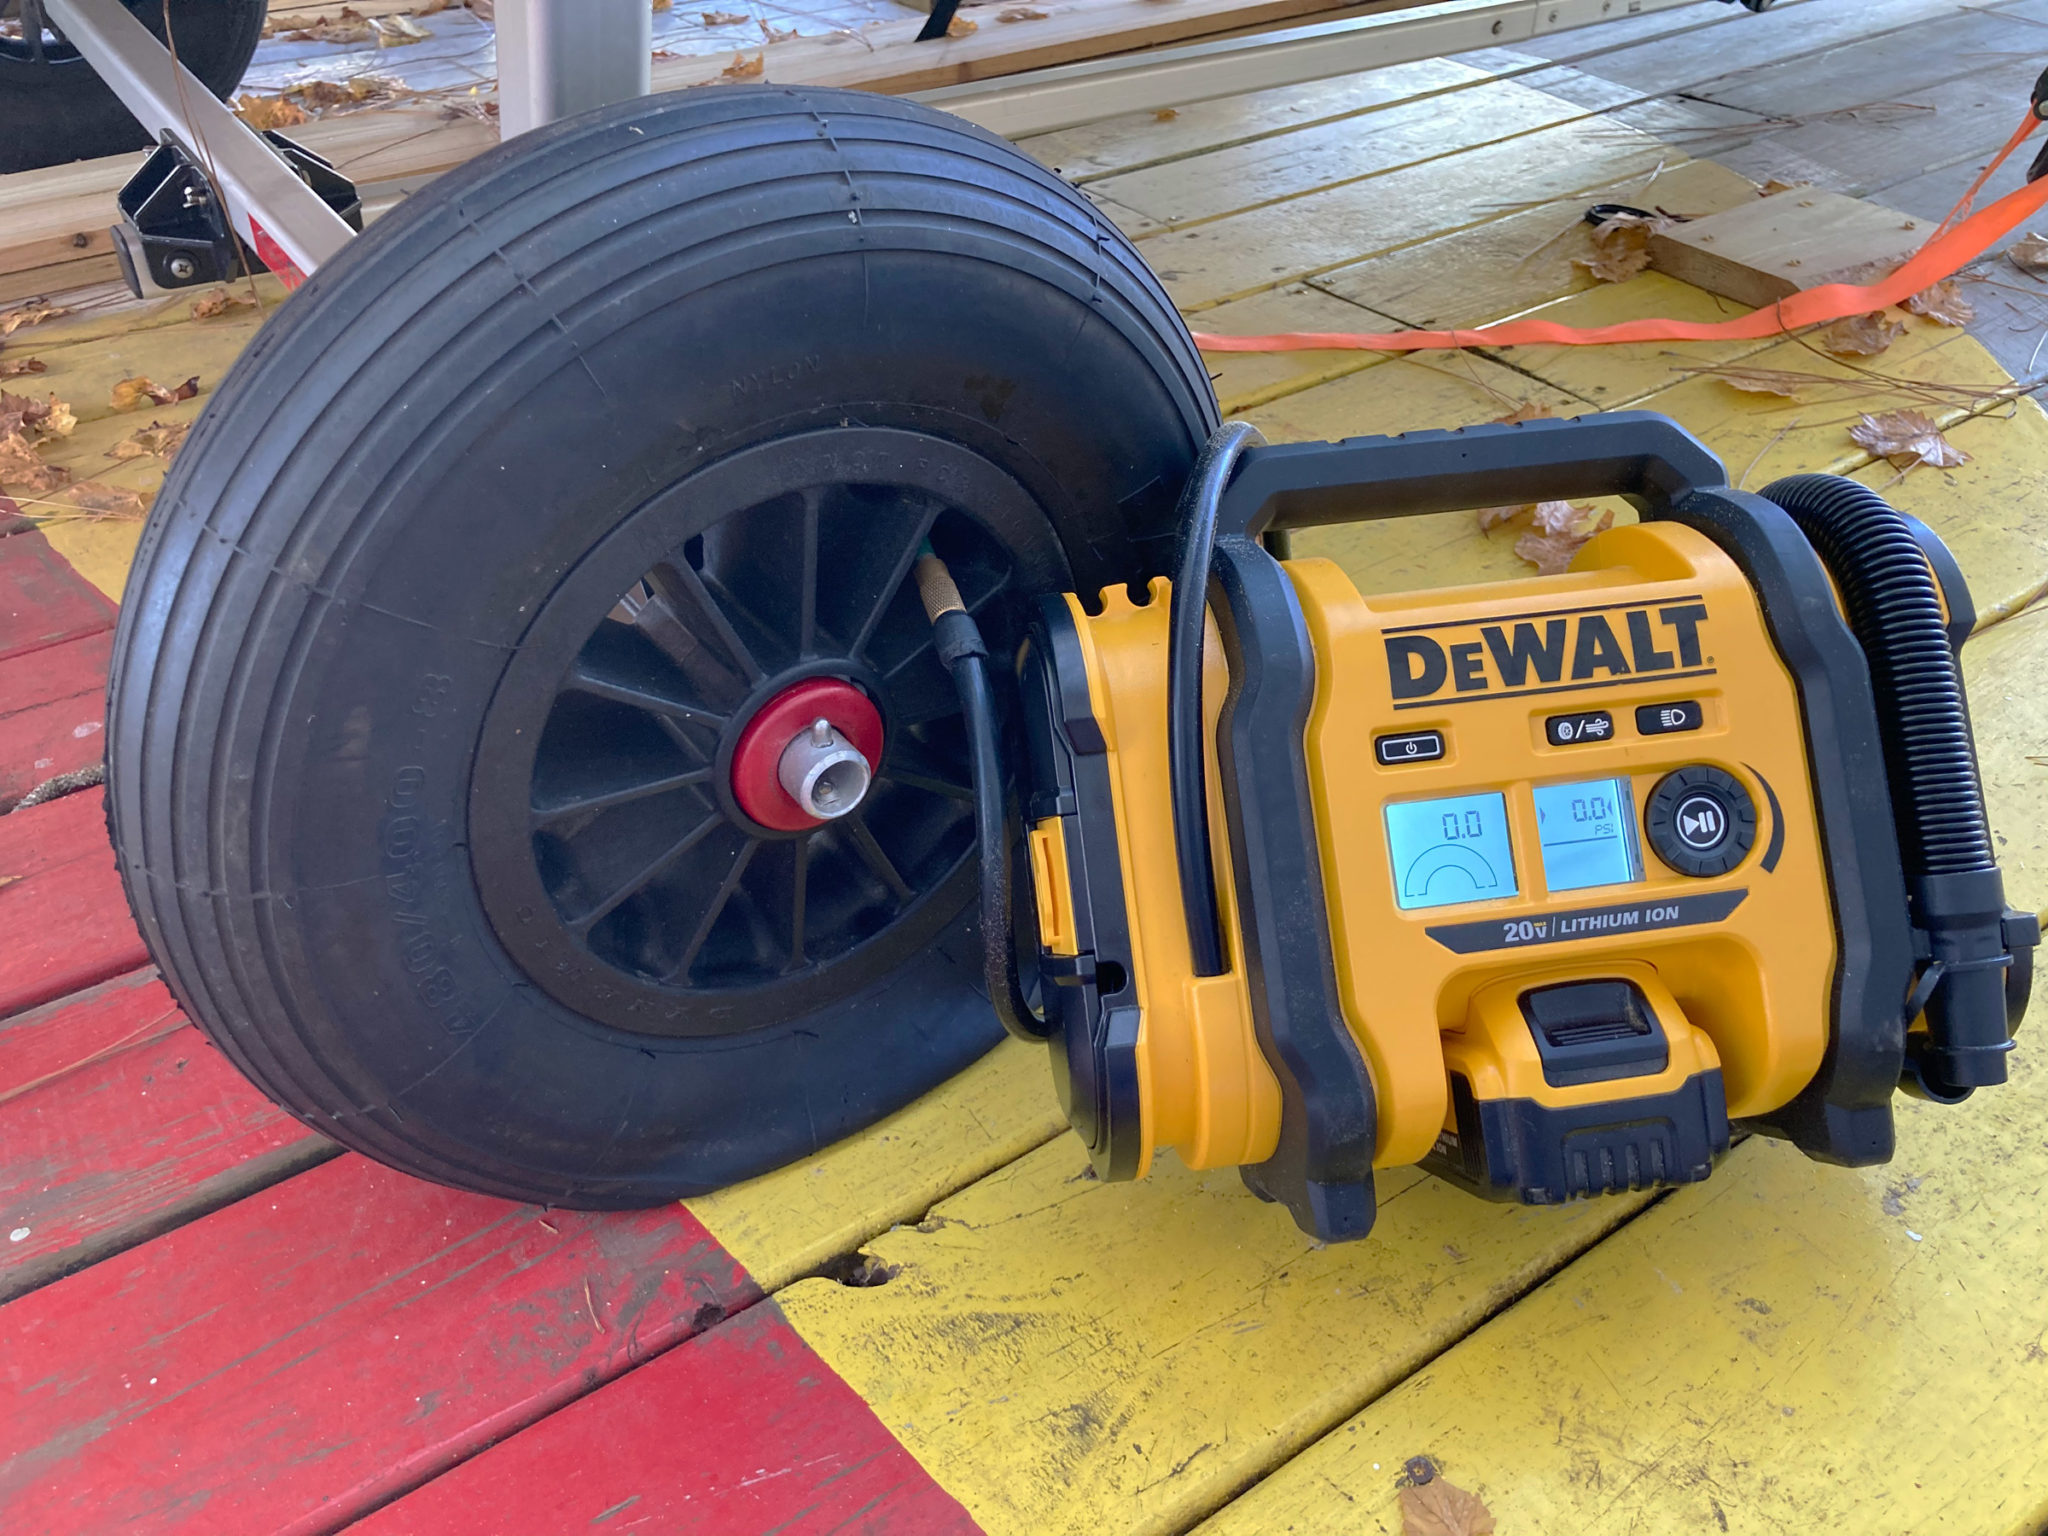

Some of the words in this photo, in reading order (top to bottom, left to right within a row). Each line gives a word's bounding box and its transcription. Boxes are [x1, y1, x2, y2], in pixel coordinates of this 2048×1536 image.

[728, 353, 822, 397] NYLON
[1571, 796, 1607, 822] 0.0
[1442, 810, 1483, 840] 0.0
[1594, 823, 1614, 836] PSI
[1560, 911, 1640, 934] LITHIUM
[1645, 905, 1680, 923] ION
